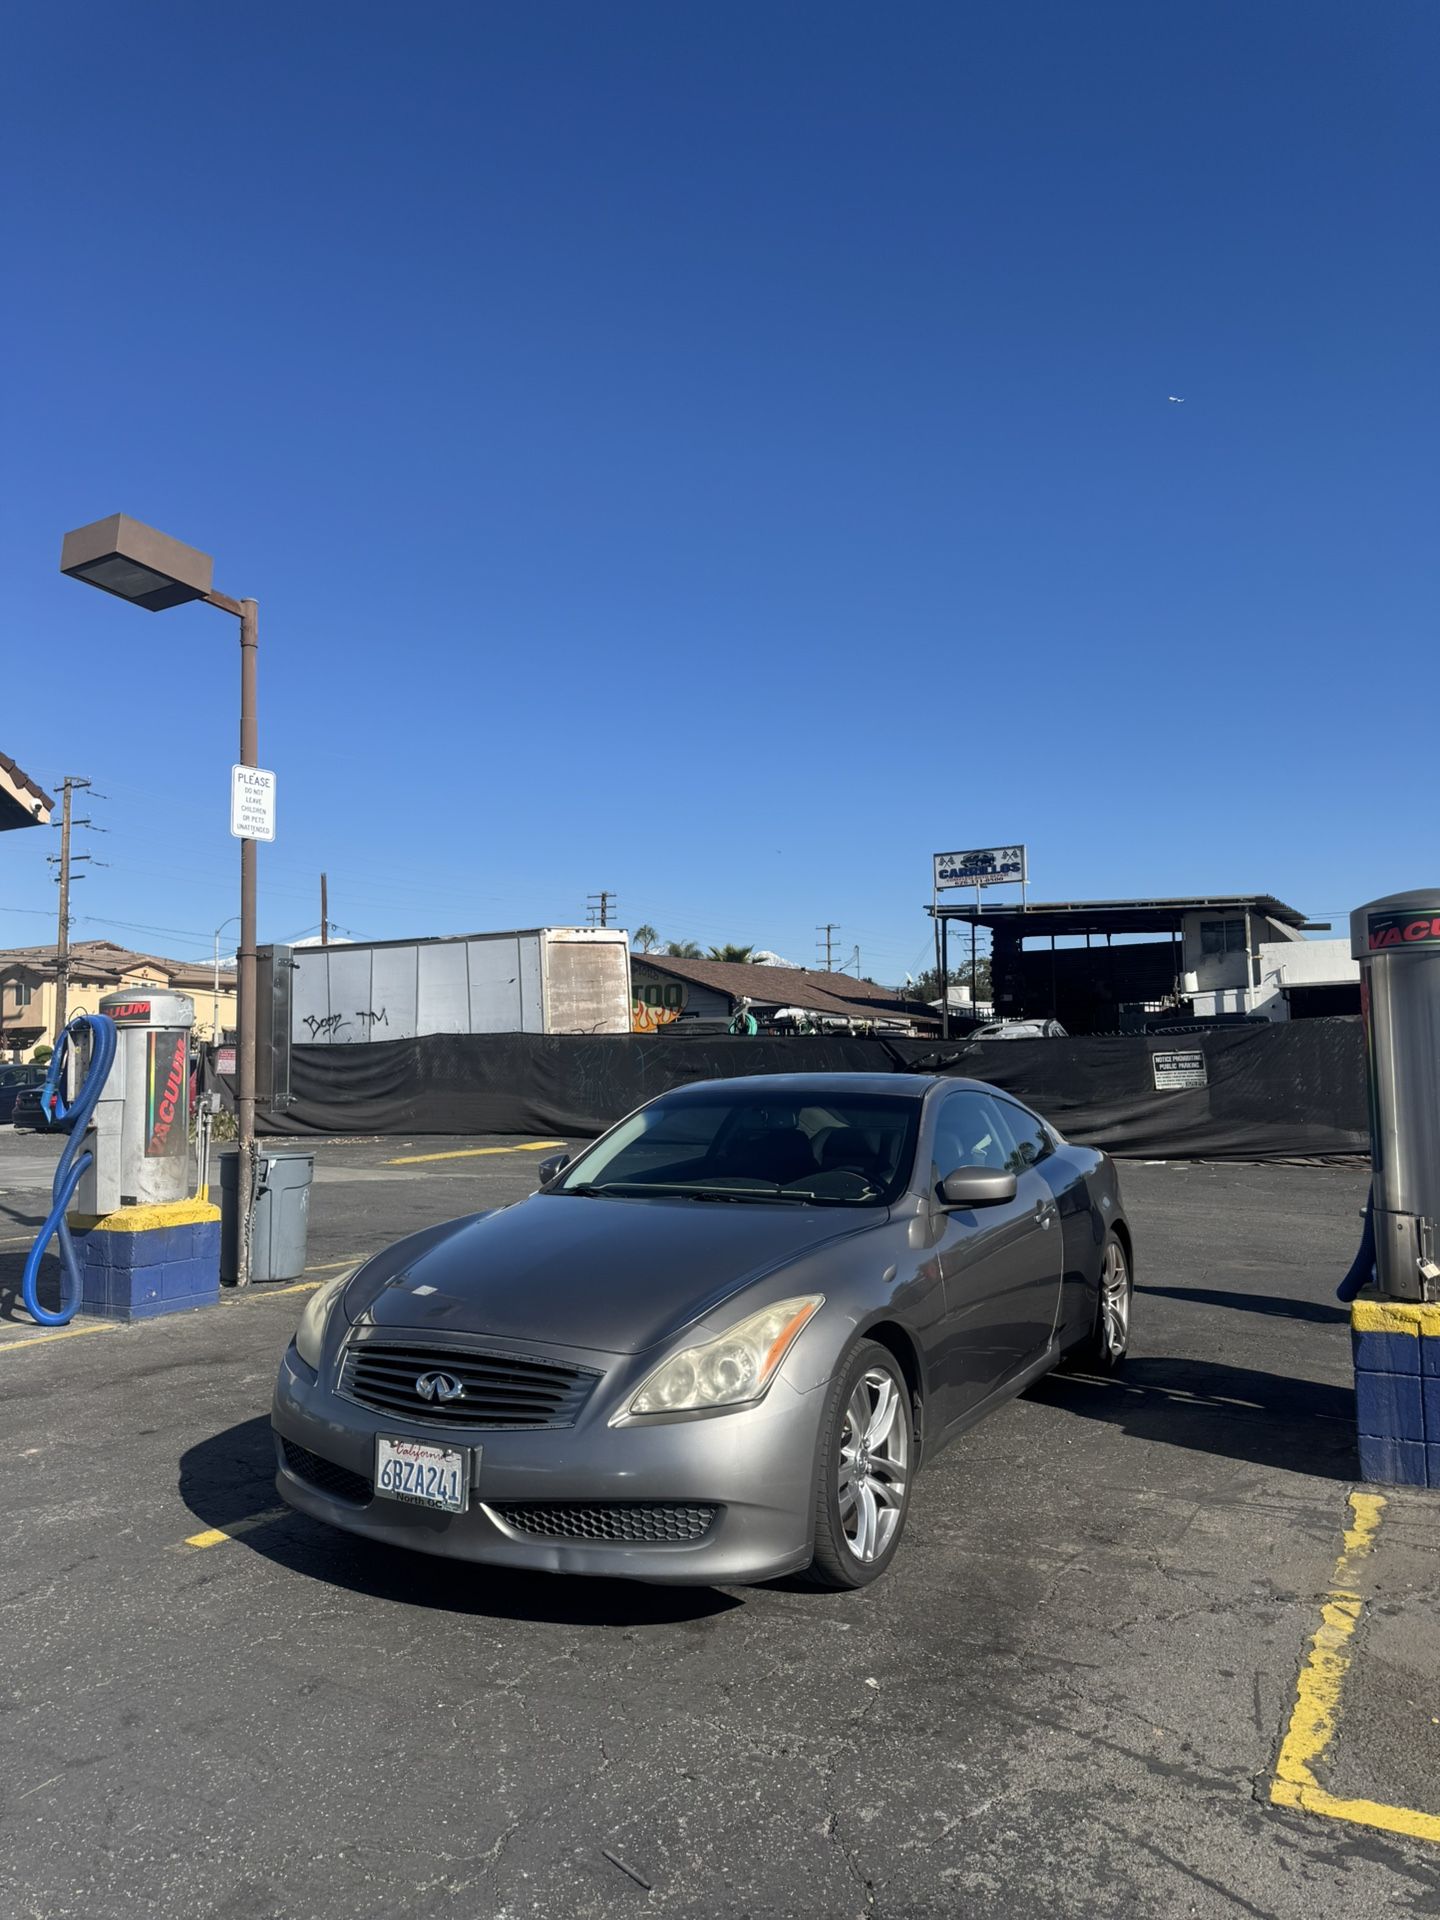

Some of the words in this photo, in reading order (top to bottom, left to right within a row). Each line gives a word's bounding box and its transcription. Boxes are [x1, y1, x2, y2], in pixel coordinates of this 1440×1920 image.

[238, 773, 271, 788] PLEASE
[245, 796, 262, 805] LEAVE
[241, 805, 267, 815] CHILDREN
[251, 816, 265, 824] PETS
[236, 823, 270, 834] UNATTENDED
[938, 862, 1021, 879] CARRILLOS
[148, 1038, 186, 1154] VACUUM
[382, 1459, 459, 1501] 6BZA241
[397, 1493, 425, 1506] North
